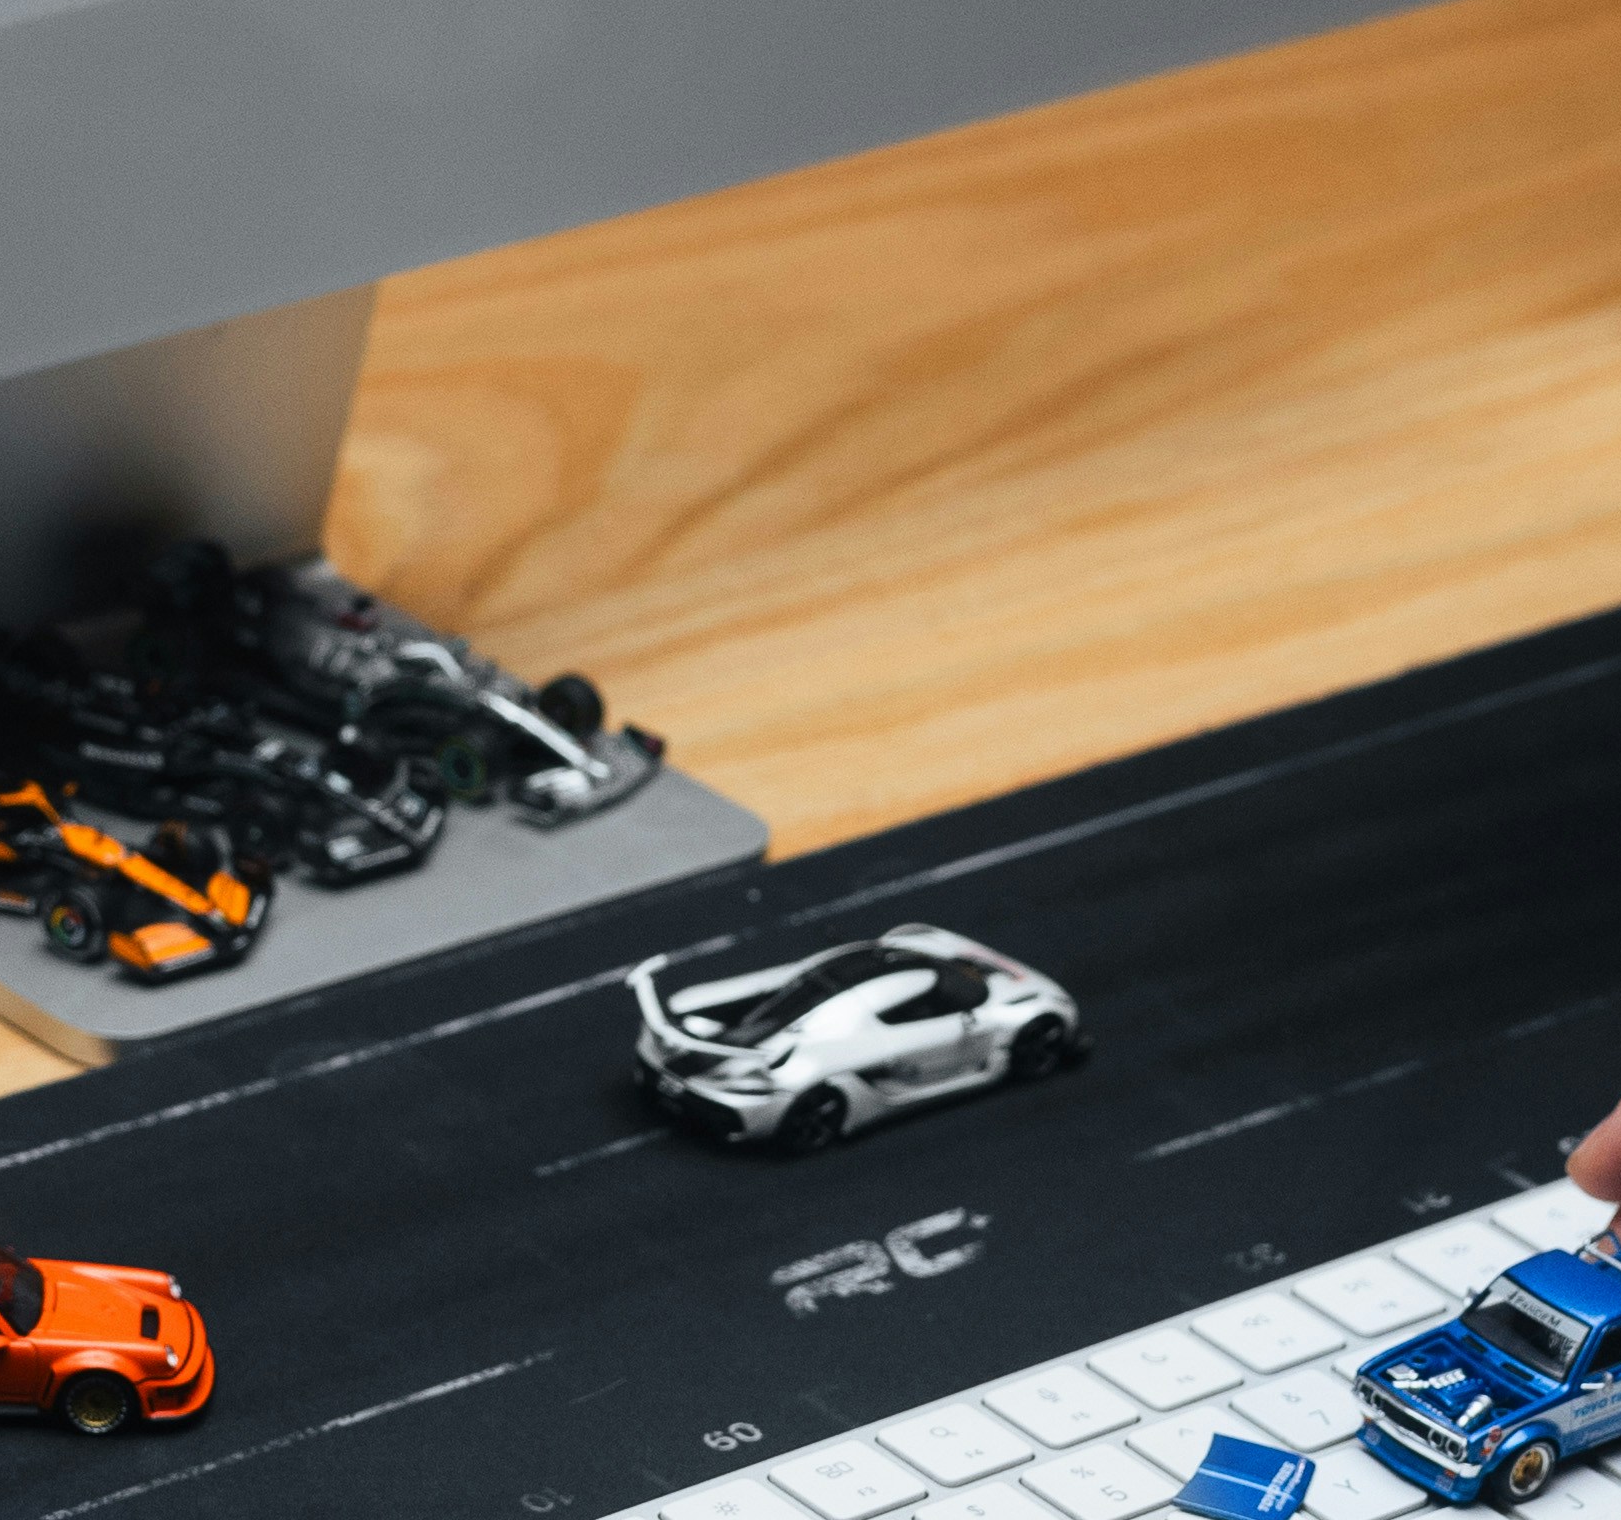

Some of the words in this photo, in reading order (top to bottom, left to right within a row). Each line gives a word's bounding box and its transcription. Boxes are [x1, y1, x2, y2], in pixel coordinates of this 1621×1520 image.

[857, 1485, 877, 1498] F3
[1100, 1484, 1129, 1502] 5
[1336, 1478, 1361, 1496] Y
[966, 1504, 986, 1517] $
